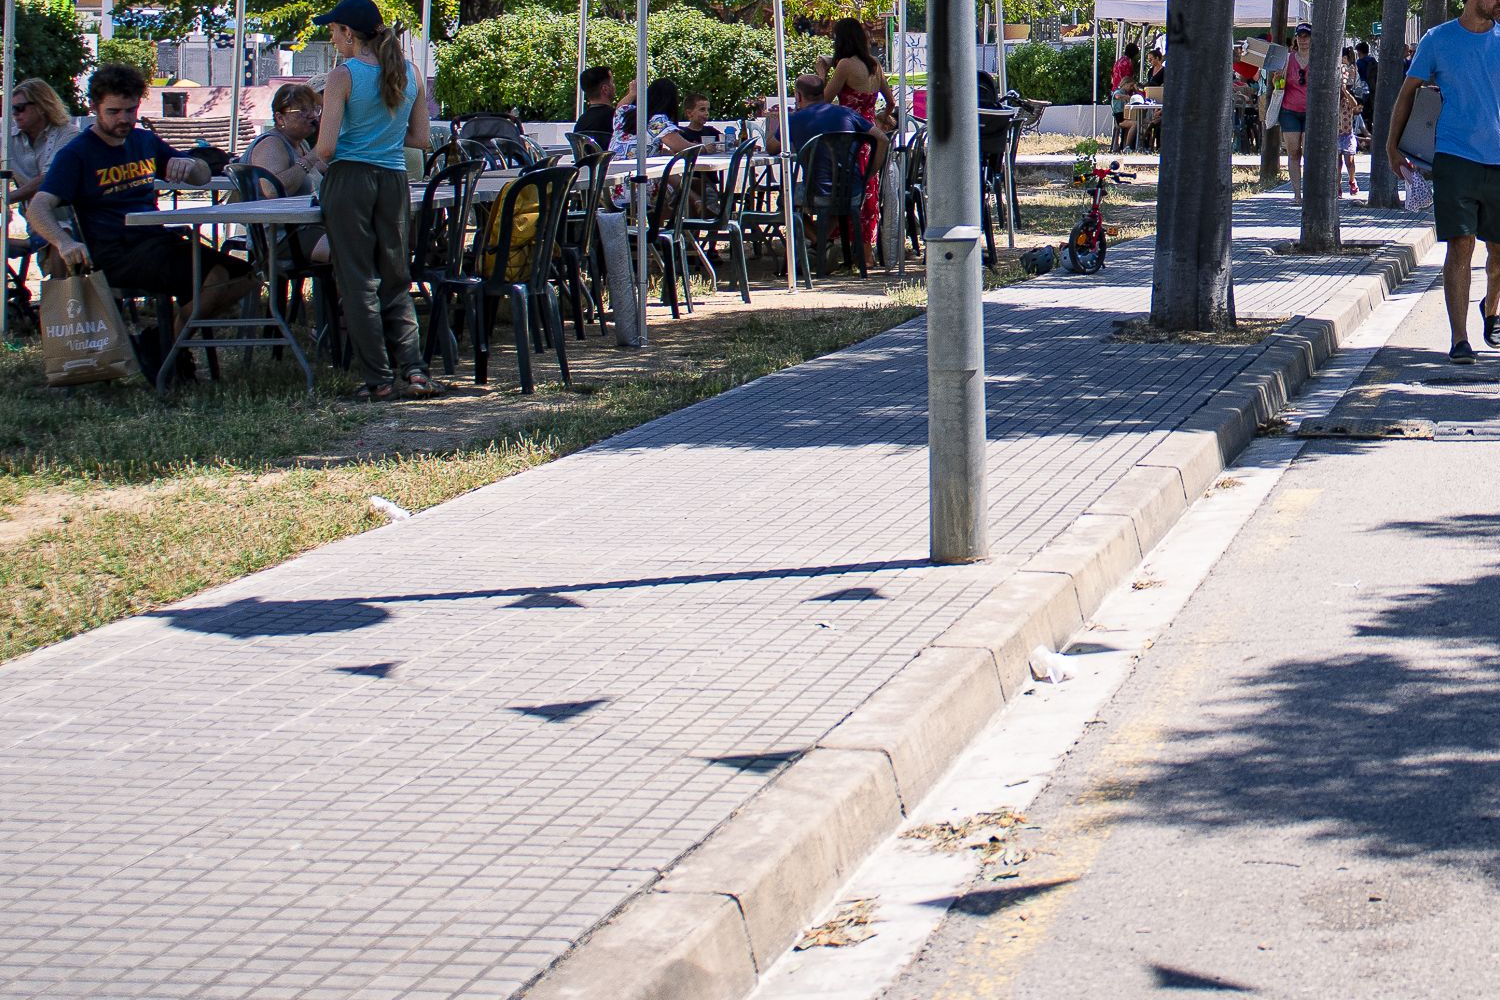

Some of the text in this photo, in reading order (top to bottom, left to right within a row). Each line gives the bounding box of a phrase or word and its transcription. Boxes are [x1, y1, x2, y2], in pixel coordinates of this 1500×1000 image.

[95, 157, 156, 187] ZOHRAN
[46, 320, 108, 338] HUMANA
[66, 337, 109, 351] Vintage
